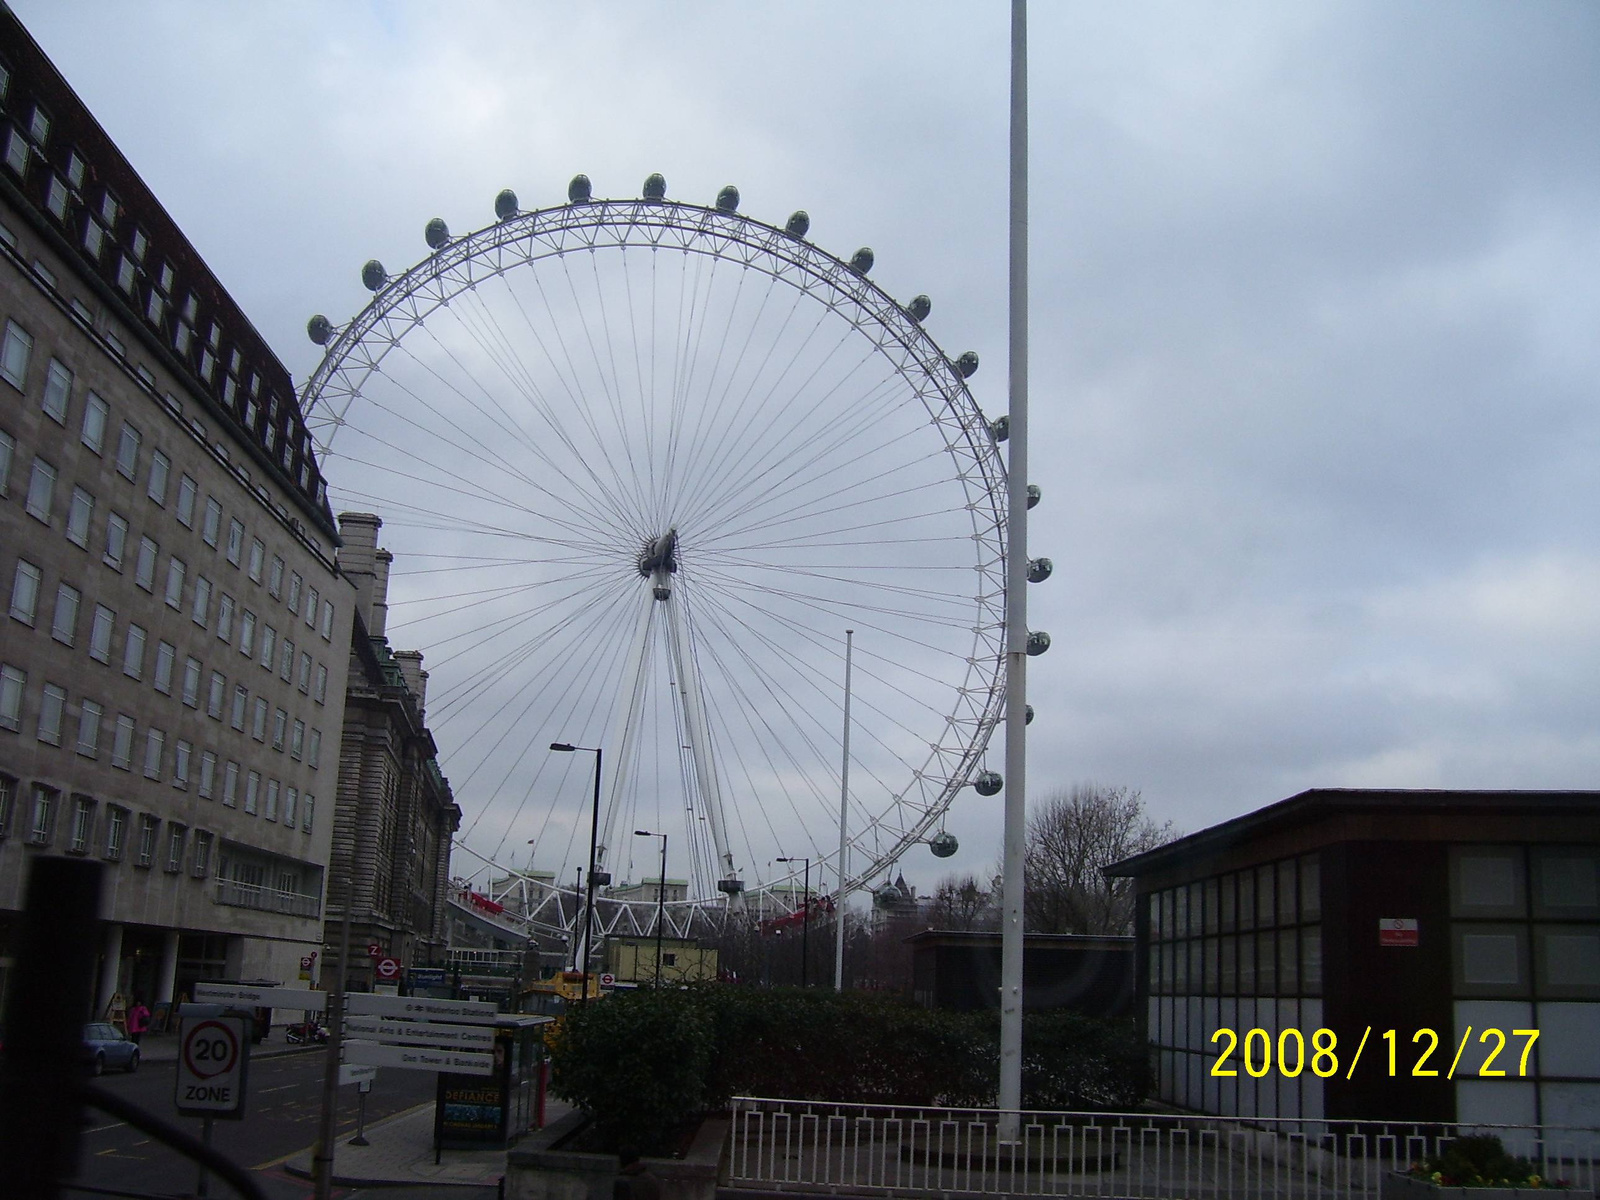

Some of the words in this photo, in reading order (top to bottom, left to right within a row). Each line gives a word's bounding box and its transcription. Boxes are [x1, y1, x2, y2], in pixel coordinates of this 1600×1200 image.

[370, 945, 378, 955] Z
[239, 991, 260, 1001] Bridge
[426, 1005, 460, 1015] Waterloo
[462, 1008, 494, 1018] Stations
[379, 1026, 394, 1035] Arts
[397, 1028, 403, 1036] &
[406, 1028, 458, 1039] Entertainment
[461, 1032, 492, 1042] Centres
[196, 1039, 227, 1061] 20
[420, 1055, 442, 1064] Tower
[445, 1057, 451, 1065] &
[186, 1086, 230, 1102] ZONE
[445, 1090, 502, 1103] DEFIANCE
